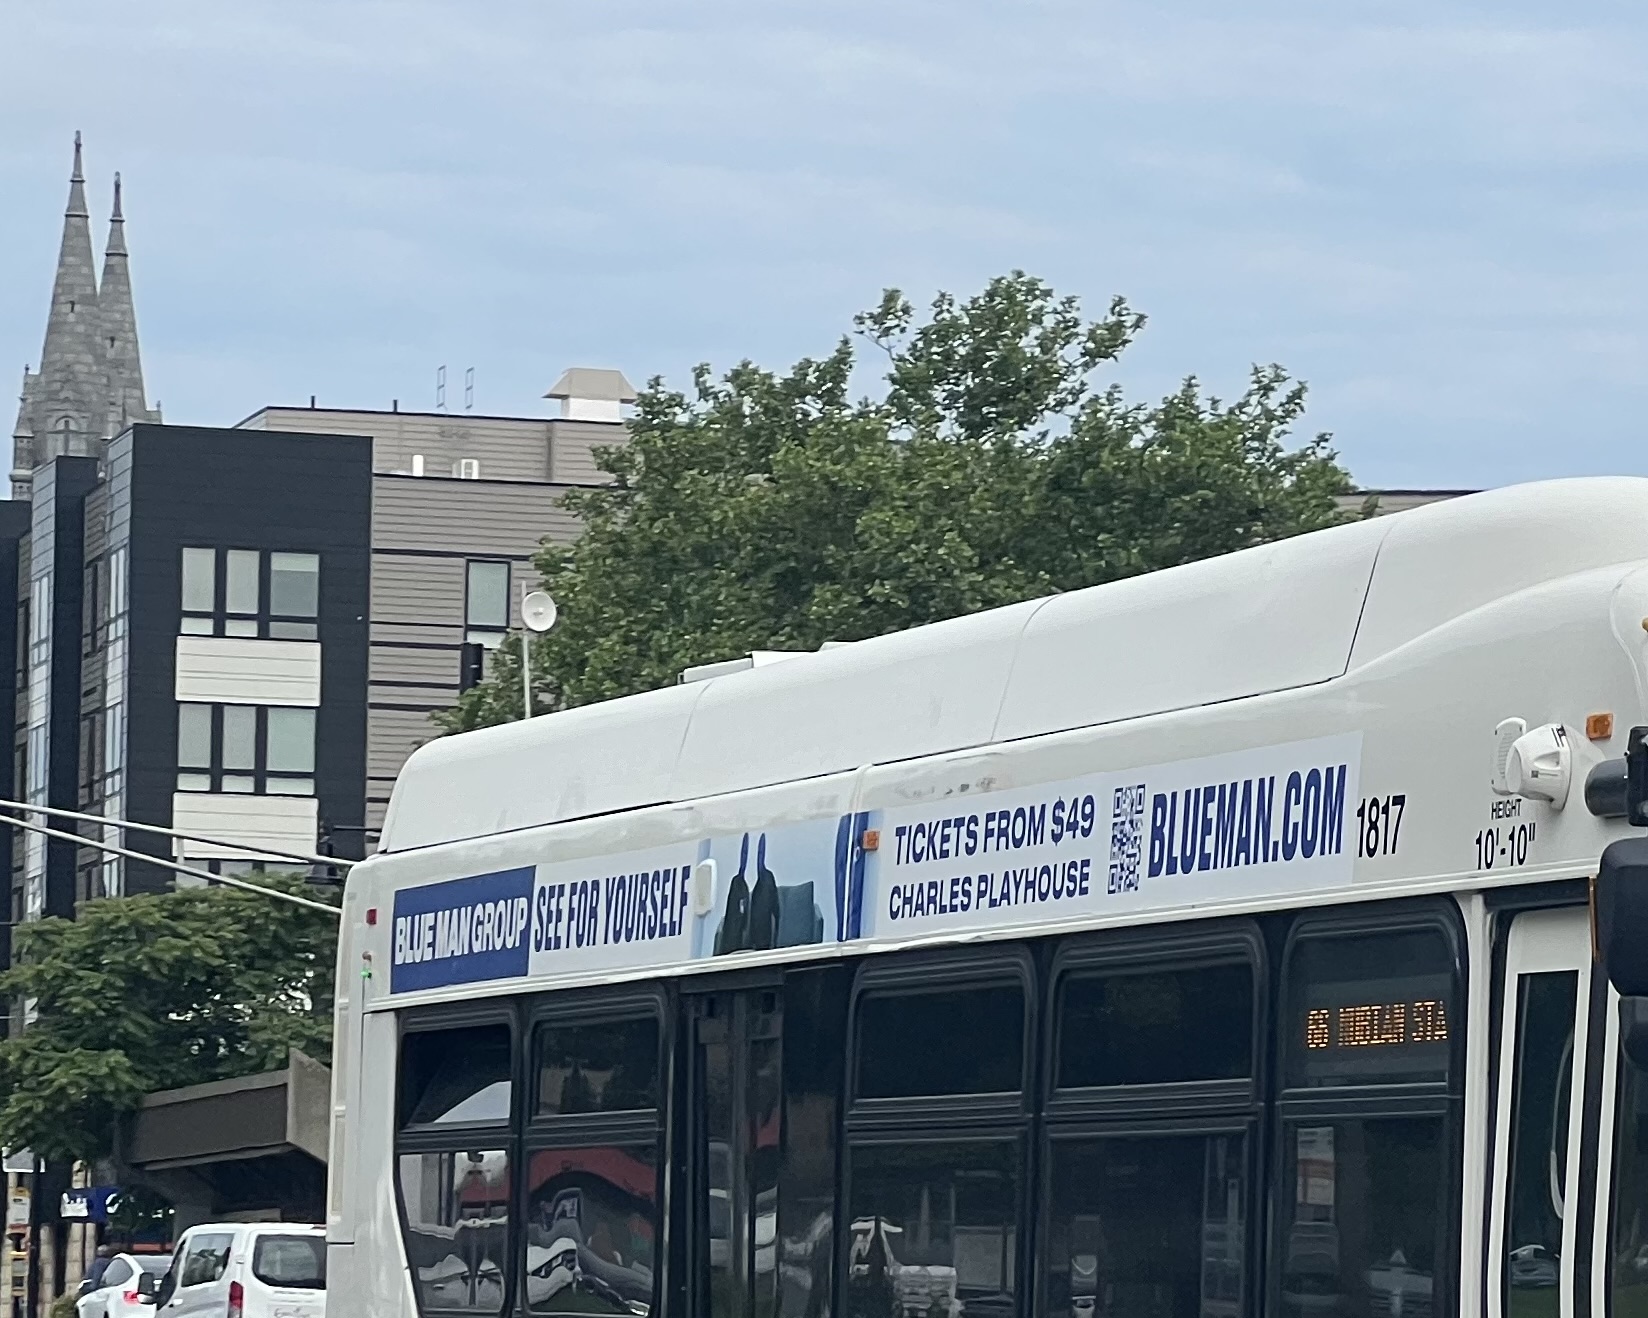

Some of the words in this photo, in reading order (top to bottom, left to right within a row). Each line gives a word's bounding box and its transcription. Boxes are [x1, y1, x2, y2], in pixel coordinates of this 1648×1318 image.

[895, 812, 978, 867] TICKETS
[984, 803, 1046, 855] FROM
[1051, 794, 1096, 846] $49
[1147, 763, 1348, 879] BLUEMAN.COM
[1357, 794, 1406, 859] 1817
[1491, 798, 1522, 820] HEIGHT
[533, 882, 566, 953] SEE
[568, 876, 599, 949] FOR
[602, 863, 691, 945] YOURSELF
[889, 869, 973, 922] CHARLES
[976, 858, 1091, 911] PLAYHOUSE
[394, 911, 437, 966] BLUE
[436, 904, 472, 960] MAN
[471, 896, 528, 954] GROUP
